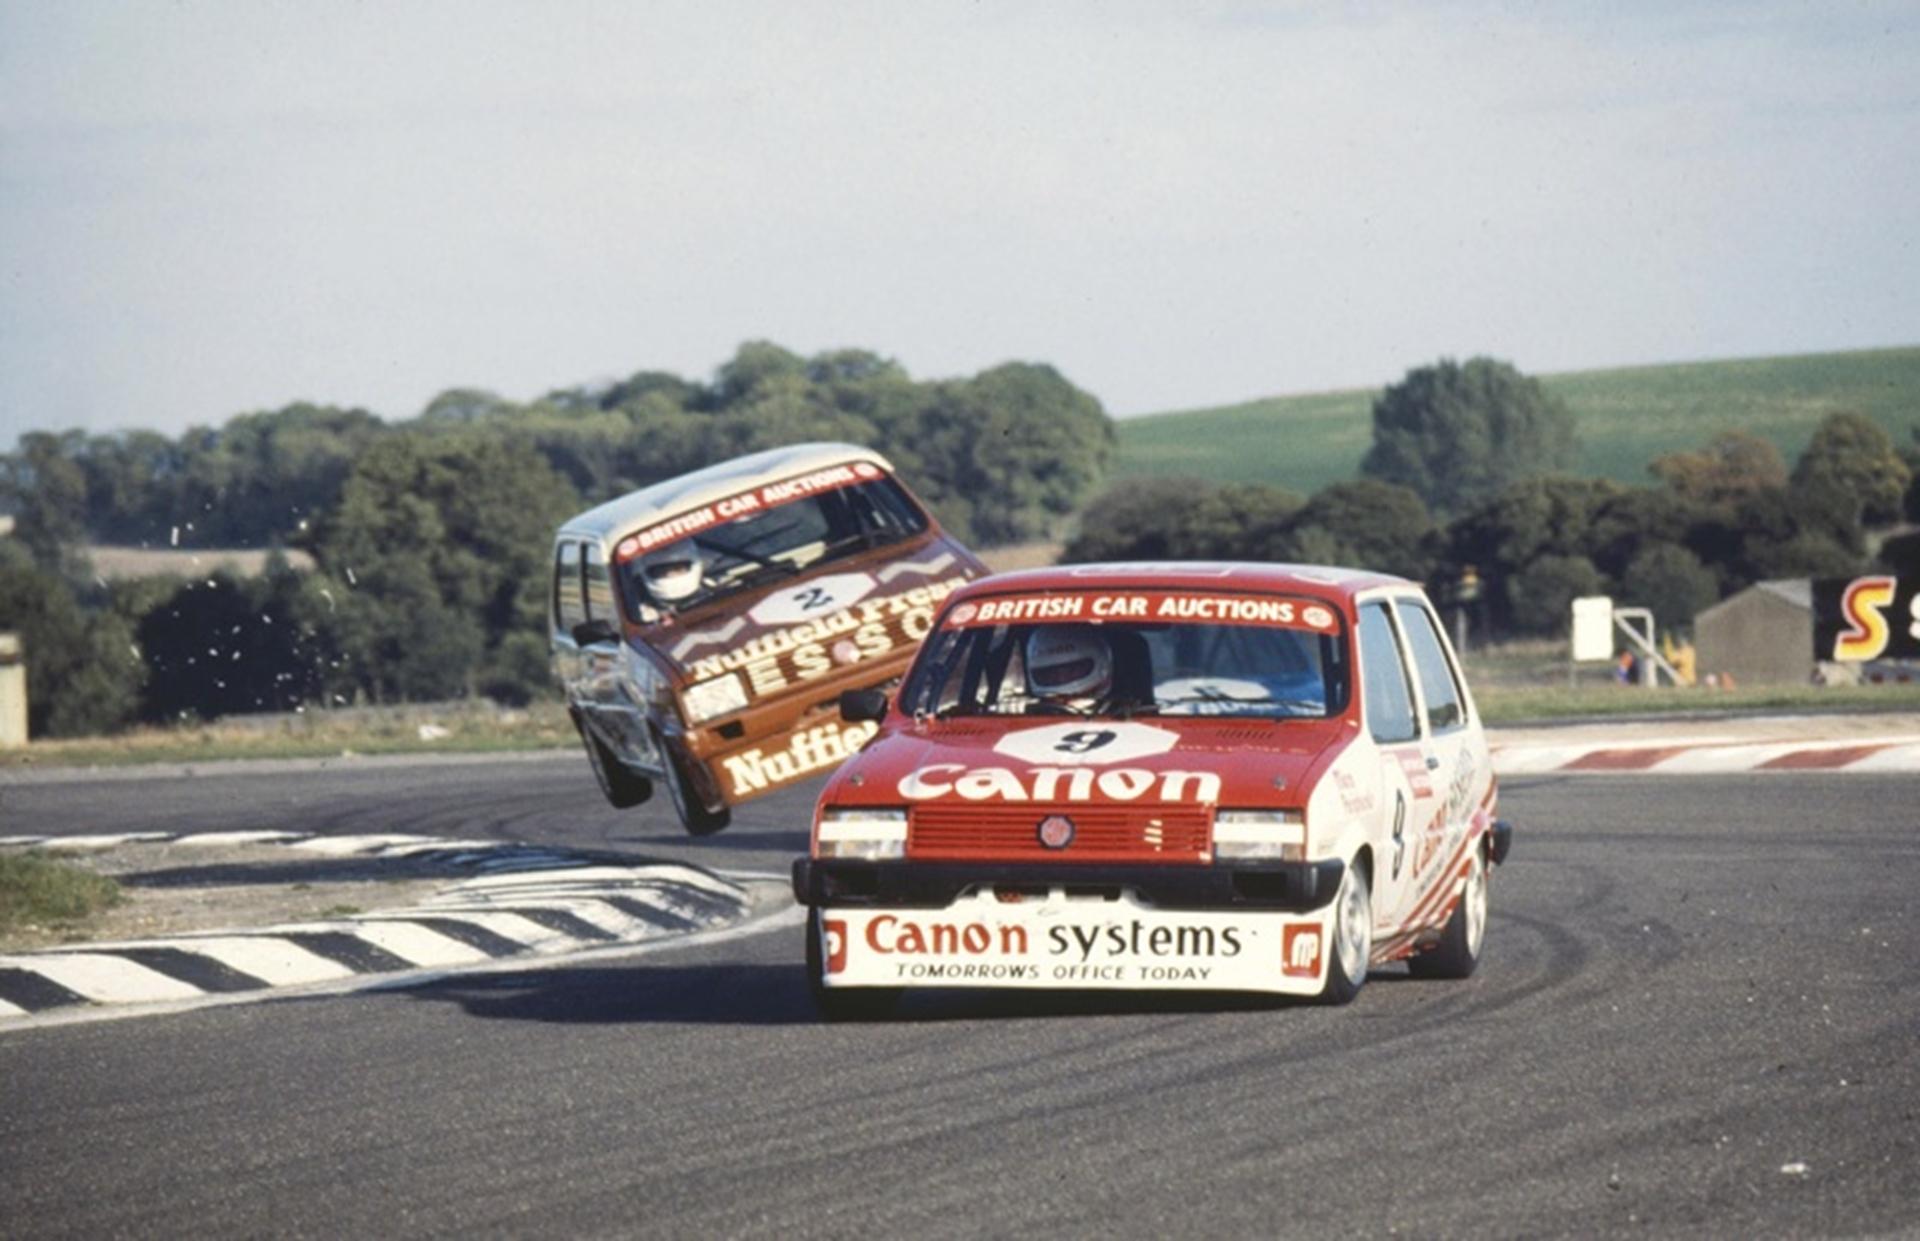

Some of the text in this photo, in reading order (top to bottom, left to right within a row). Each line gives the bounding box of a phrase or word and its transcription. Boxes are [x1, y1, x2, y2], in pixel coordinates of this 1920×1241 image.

[638, 466, 855, 549] BRITISH CAR AUCTIONS
[794, 587, 834, 610] 2
[977, 596, 1295, 623] BRITISH CAR AUCTIONS
[1833, 576, 1896, 662] S
[690, 607, 860, 680] Nuffield
[1053, 728, 1117, 753] 9
[898, 764, 1222, 803] Canon
[864, 914, 1029, 956] Canon
[1048, 919, 1242, 973] systems
[896, 962, 1214, 982] TOMORROWS OFFICE TODAY
